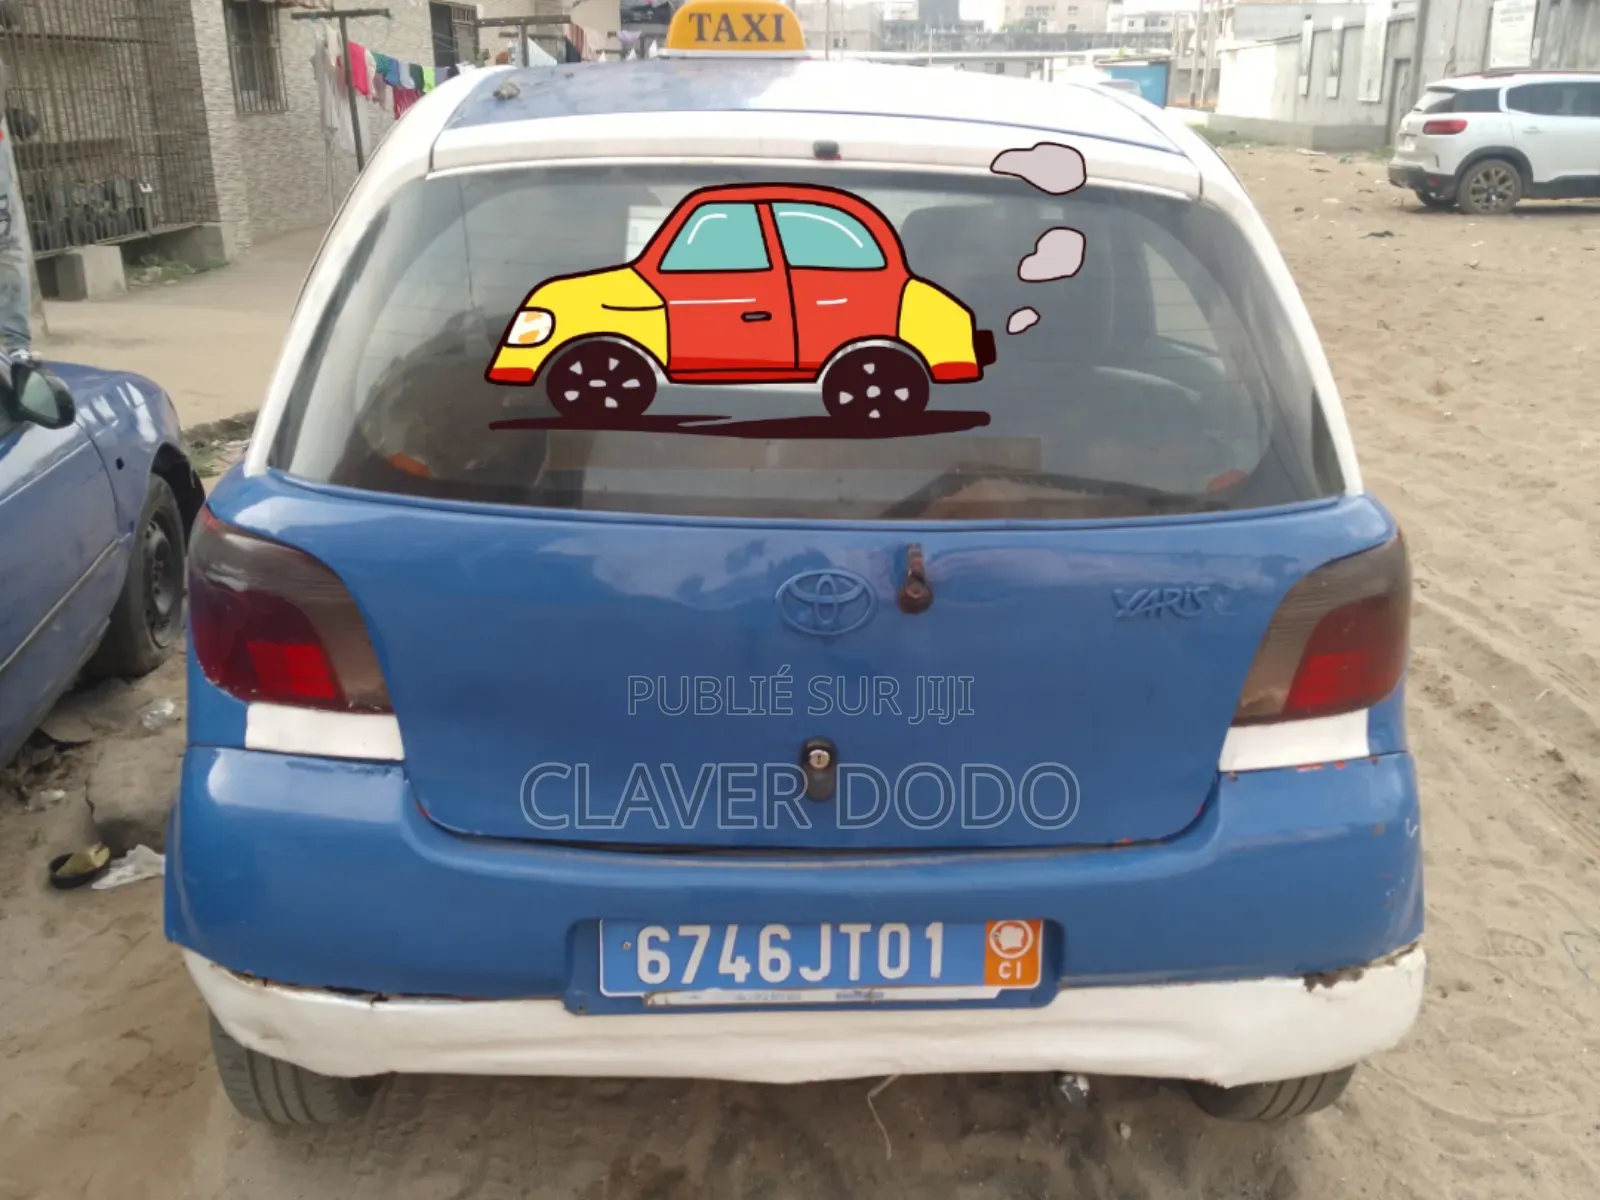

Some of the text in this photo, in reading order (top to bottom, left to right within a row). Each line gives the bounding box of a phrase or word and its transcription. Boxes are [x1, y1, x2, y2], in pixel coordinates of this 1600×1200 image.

[689, 12, 786, 42] TAXI
[636, 921, 944, 985] 6746JT01
[997, 962, 1022, 981] CI
